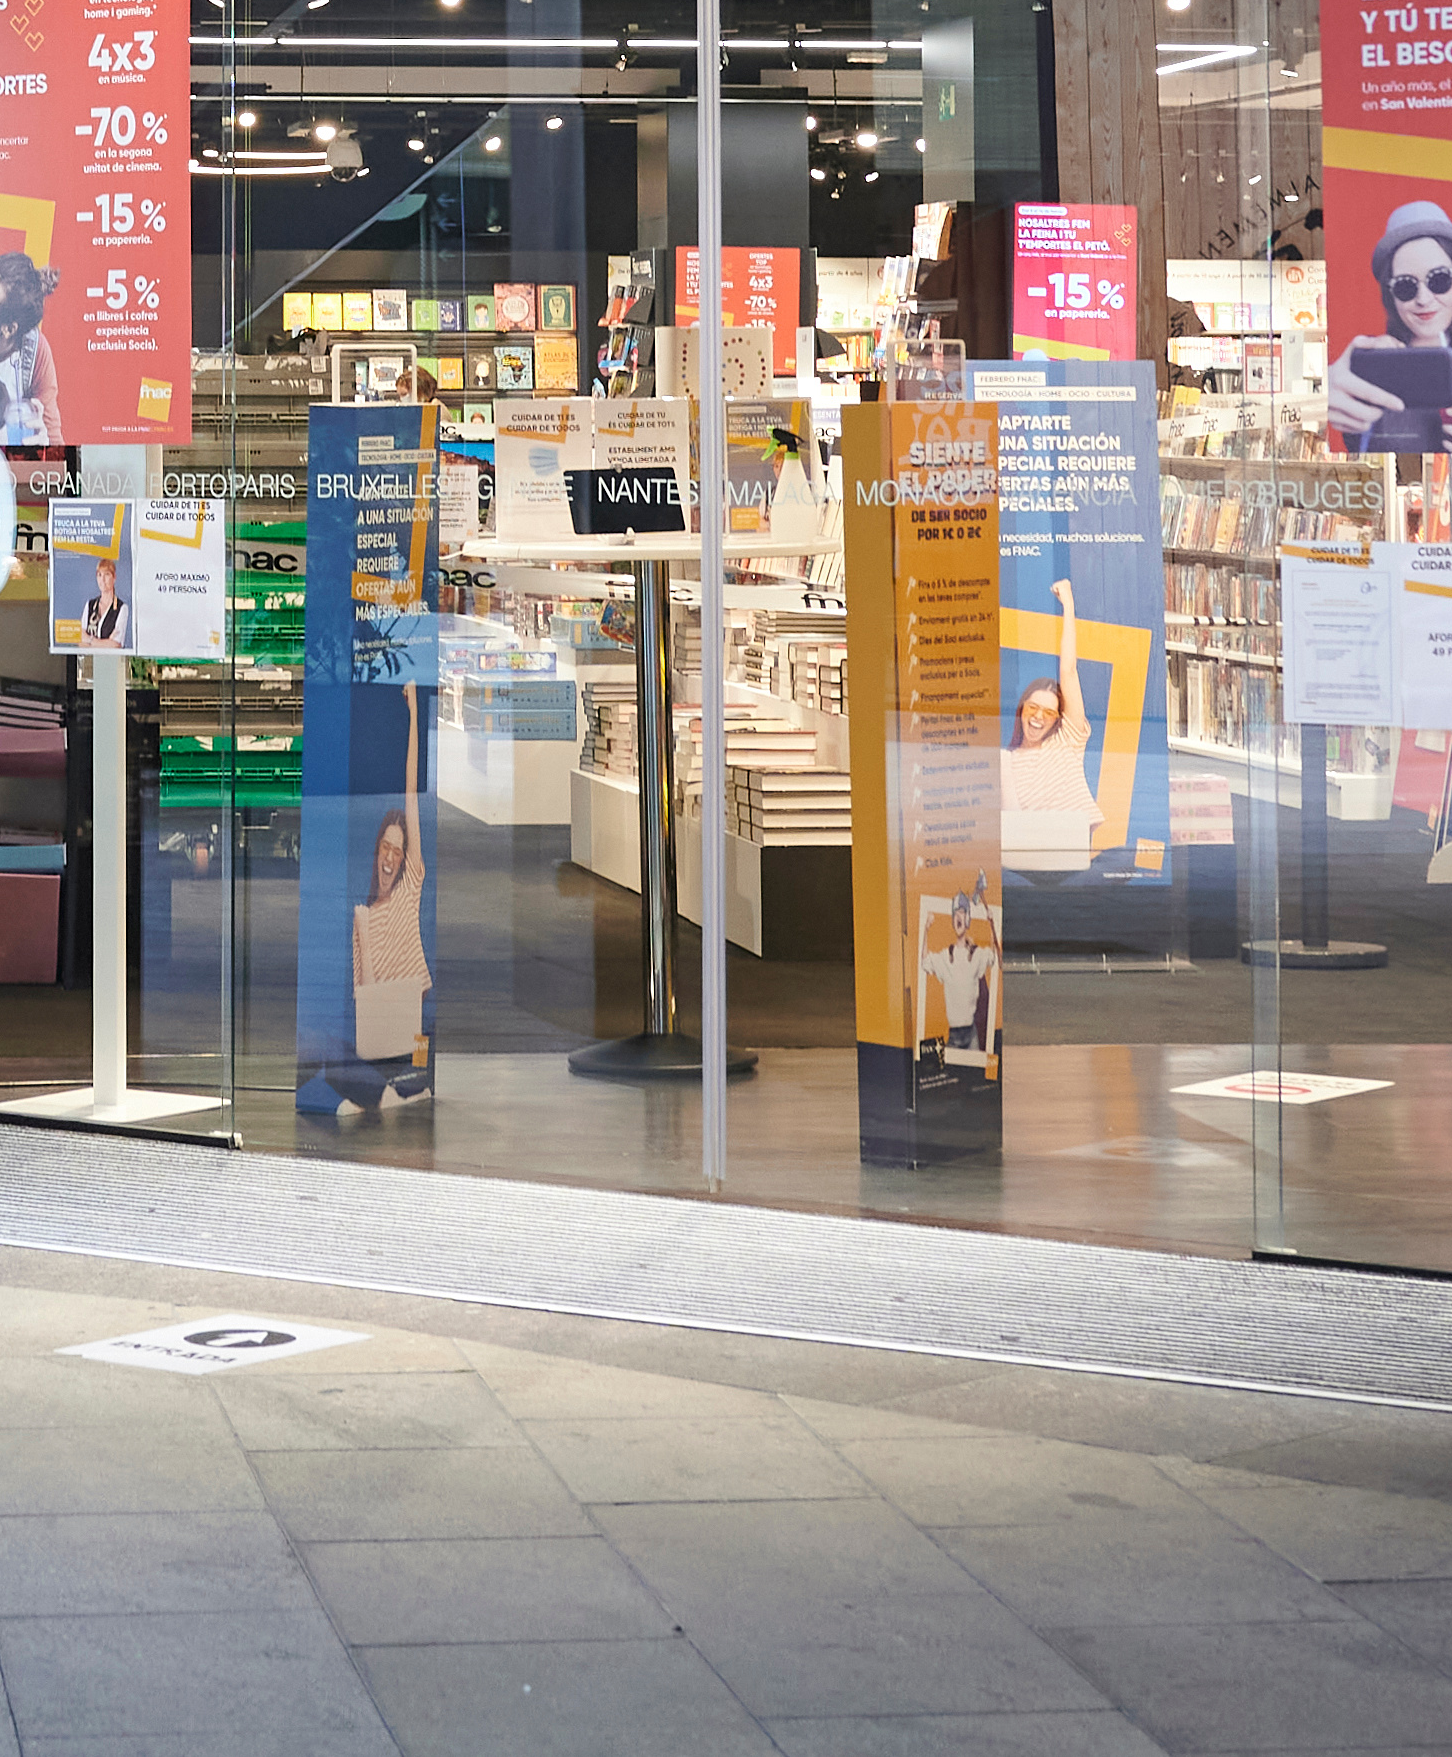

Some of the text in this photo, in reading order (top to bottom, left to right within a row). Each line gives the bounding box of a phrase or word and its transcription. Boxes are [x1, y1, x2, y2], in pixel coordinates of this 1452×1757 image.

[84, 8, 109, 19] home
[1361, 11, 1378, 34] Y
[1384, 2, 1417, 32] TÚ
[1362, 44, 1390, 67] EL
[98, 76, 109, 84] en
[1362, 82, 1378, 93] Un
[1439, 78, 1451, 90] el
[1362, 101, 1377, 111] en
[1380, 98, 1404, 110] San
[75, 105, 136, 146] -70
[95, 148, 152, 160] en la segona
[84, 162, 162, 174] unitat de cinema.
[77, 193, 135, 233] -15
[93, 237, 104, 246] en
[87, 269, 128, 310] -5
[1027, 273, 1091, 308] -15
[84, 310, 158, 321] en llibres i cofres
[88, 340, 126, 352] (exclusiu
[140, 385, 172, 399] fnac
[1033, 432, 1120, 450] SITUACIÓN
[1057, 456, 1136, 471] REQUIERE
[30, 471, 136, 496] GRANADA
[150, 473, 227, 497] PORTO
[231, 474, 295, 498] PARIS
[317, 474, 448, 499] BRUXELLES
[598, 476, 699, 505] NANTES
[856, 479, 981, 507] MONACO
[1263, 480, 1383, 509] BRUGES
[1054, 474, 1129, 491] AÚN MÁS
[1412, 562, 1451, 571] CUIDAR
[1433, 648, 1445, 656] 49
[111, 1341, 237, 1363] ENTRADA
